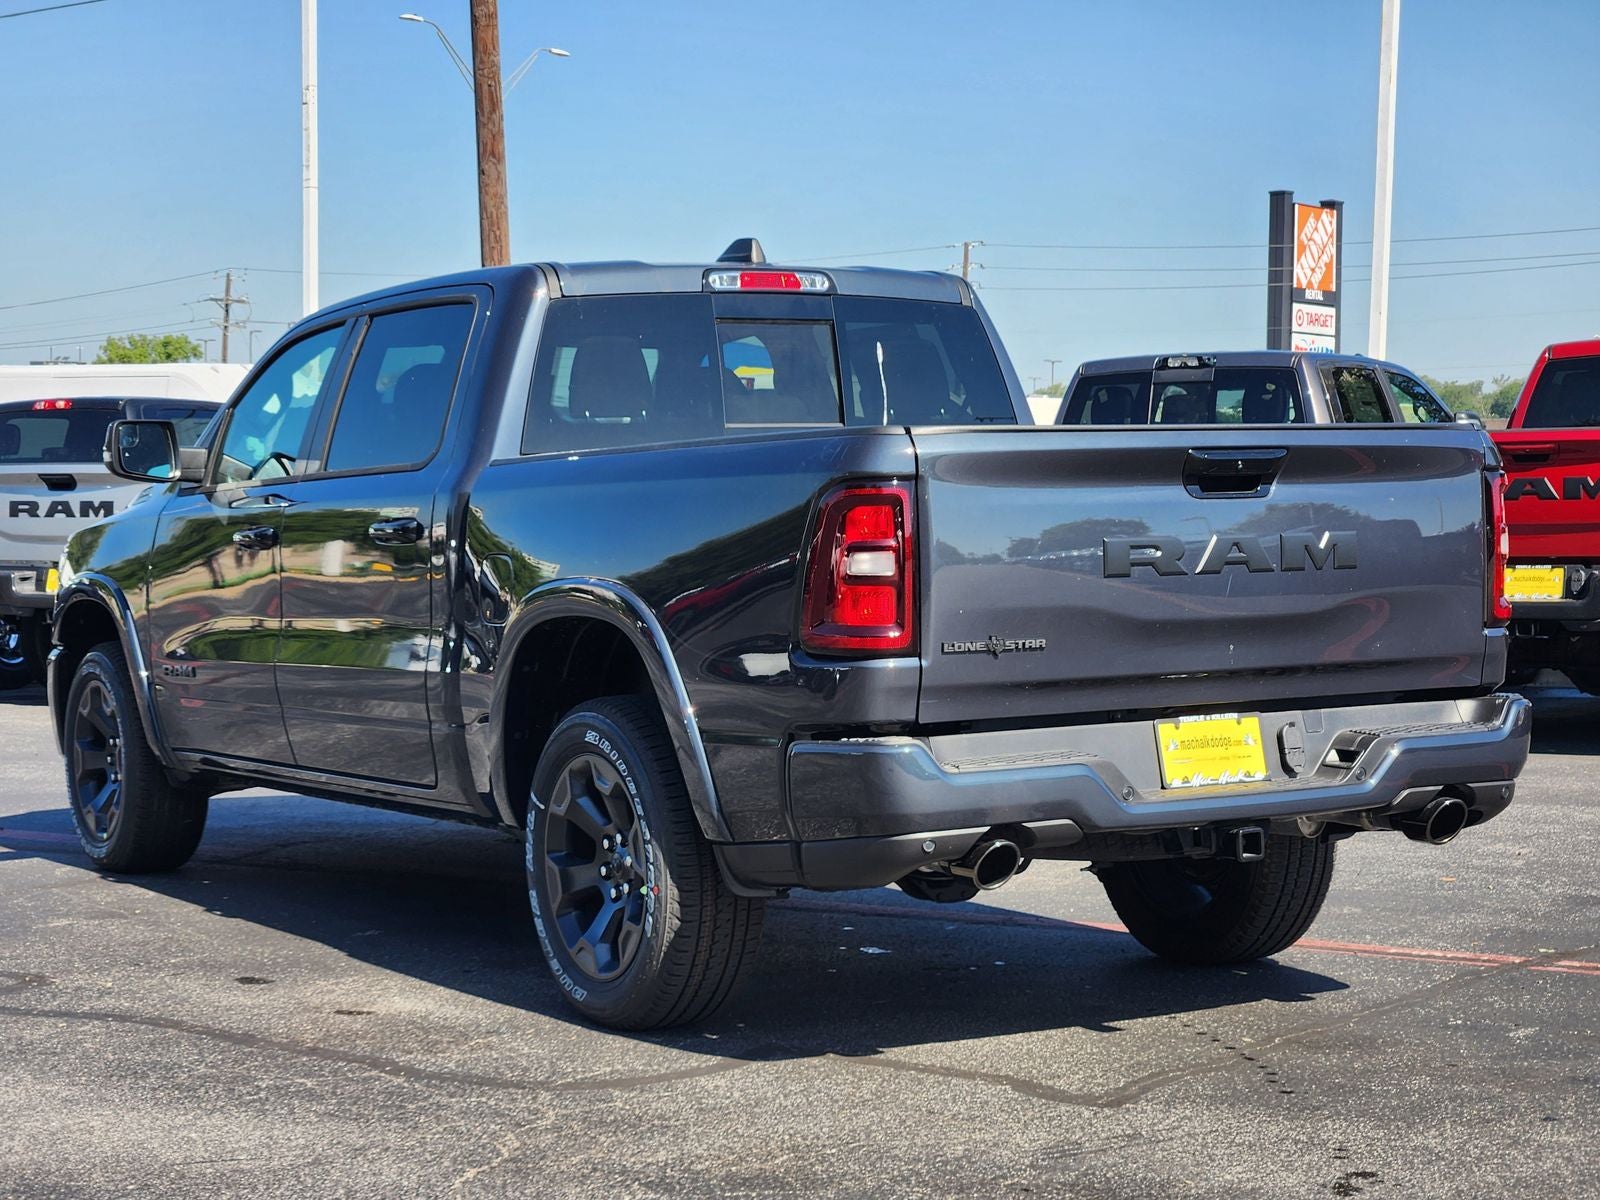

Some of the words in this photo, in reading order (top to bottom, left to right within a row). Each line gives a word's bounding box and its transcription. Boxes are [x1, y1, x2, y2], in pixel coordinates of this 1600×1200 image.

[1300, 211, 1317, 246] THE
[1296, 208, 1334, 289] HOME
[1310, 236, 1334, 290] DEPOT
[1306, 312, 1334, 328] TARGET
[1503, 476, 1600, 500] AM
[8, 500, 115, 518] RAM
[1103, 530, 1358, 579] RAM
[941, 641, 988, 656] LONE
[1004, 638, 1047, 653] STAR
[162, 664, 196, 678] RAM
